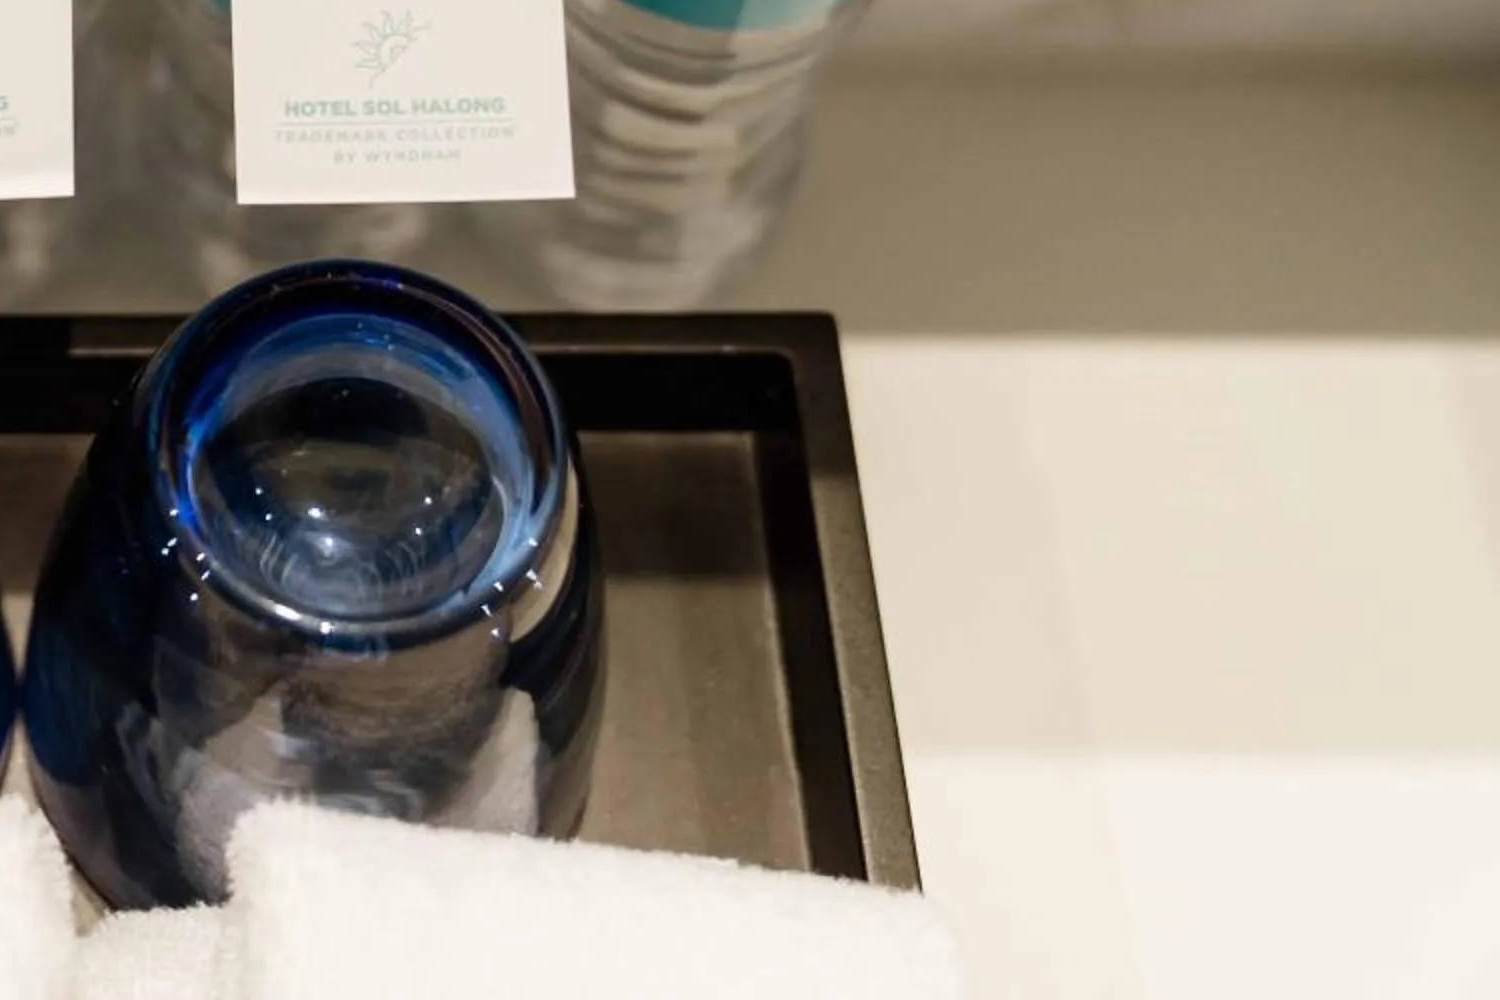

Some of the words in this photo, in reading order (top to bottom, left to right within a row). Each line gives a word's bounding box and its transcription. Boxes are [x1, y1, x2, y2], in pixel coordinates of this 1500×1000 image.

[283, 99, 357, 118] HOTEL
[362, 98, 407, 116] SOL
[411, 95, 508, 115] HALONG
[275, 128, 388, 144] TRADEMARK
[395, 125, 516, 142] COLLECTION
[364, 147, 461, 164] WYNDHAM
